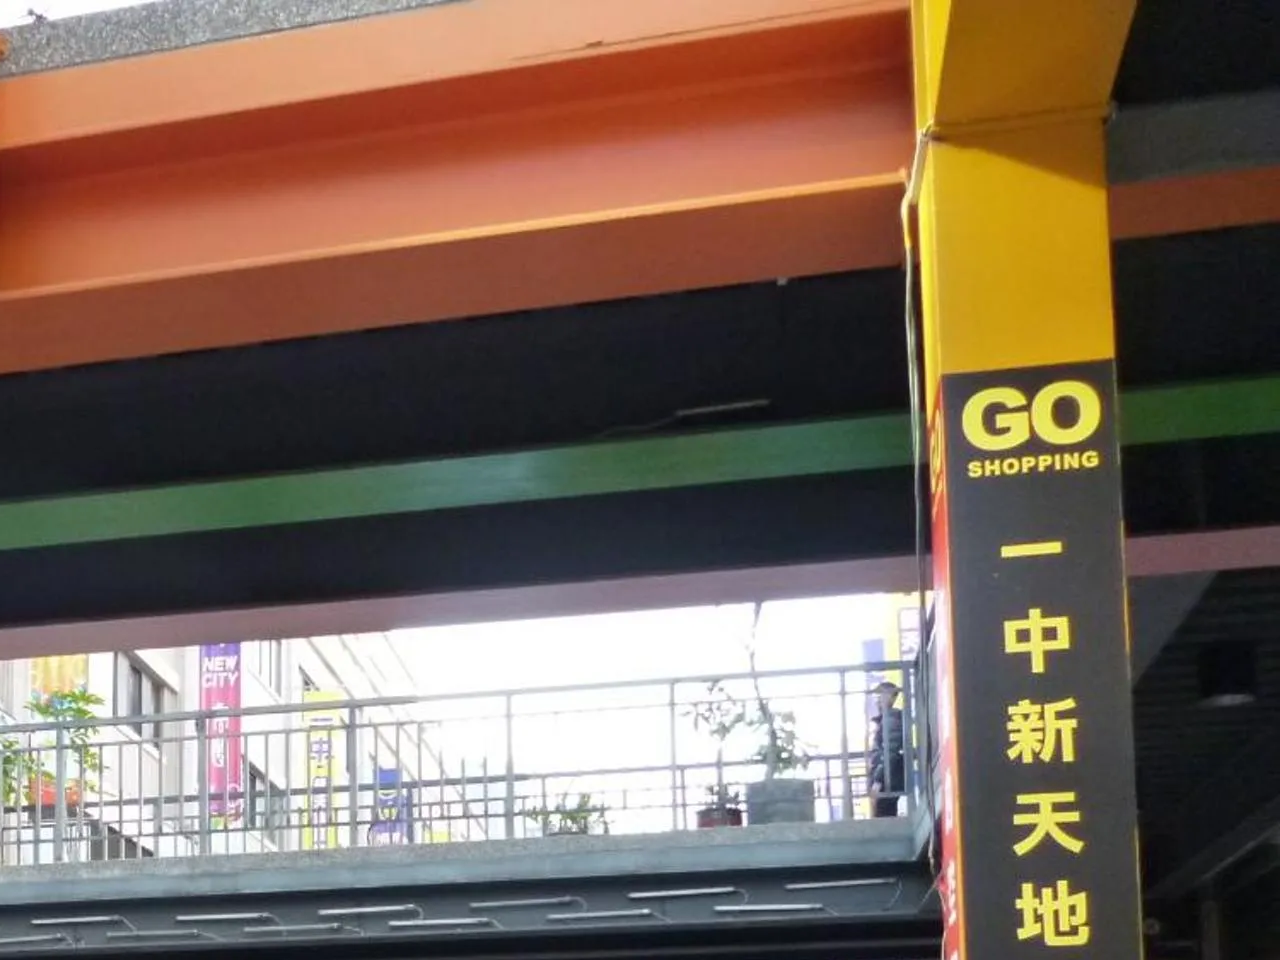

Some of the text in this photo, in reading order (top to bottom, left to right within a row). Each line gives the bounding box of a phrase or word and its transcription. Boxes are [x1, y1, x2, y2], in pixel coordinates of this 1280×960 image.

[961, 380, 1102, 451] GO
[967, 451, 1100, 478] SHOPPING
[203, 656, 237, 671] NEW
[202, 671, 239, 688] CITY
